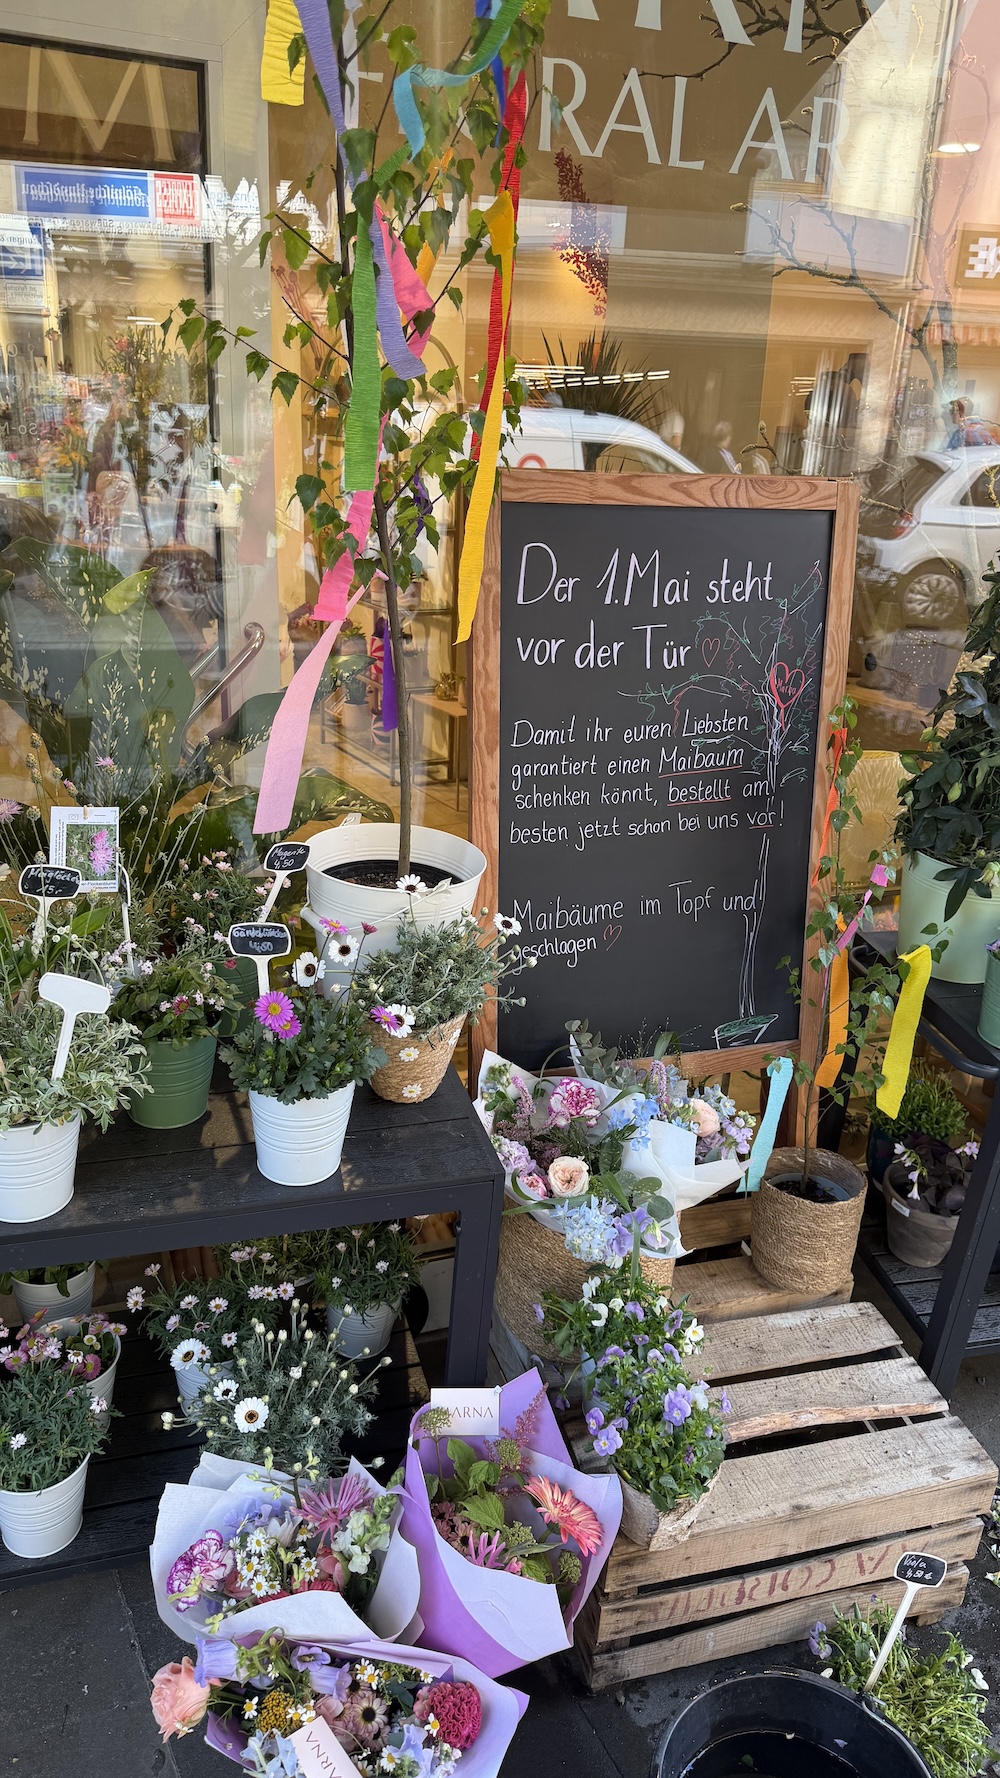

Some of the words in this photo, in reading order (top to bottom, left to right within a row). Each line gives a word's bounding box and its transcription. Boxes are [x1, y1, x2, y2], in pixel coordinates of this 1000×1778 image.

[516, 542, 580, 606] Der
[706, 558, 774, 604] steht
[516, 635, 566, 666] vor
[574, 619, 624, 669] der
[632, 624, 691, 669] Tür
[511, 715, 577, 748] Damit
[586, 718, 612, 743] ihr
[624, 722, 672, 744] euren
[682, 709, 749, 738] Liebsten
[512, 756, 597, 792] garantiert
[608, 755, 650, 776] einen
[658, 746, 744, 774] Maibaum
[514, 785, 590, 810] schenken
[600, 787, 658, 806] könnt,
[668, 778, 732, 803] bestellt
[742, 780, 770, 798] am
[510, 821, 569, 844] besten
[576, 820, 621, 852] jetzt
[628, 819, 671, 837] schon
[678, 812, 701, 832] bei
[707, 810, 739, 830] uns
[512, 896, 624, 934] Maibäume
[640, 895, 661, 916] im
[668, 879, 716, 922] Topf
[723, 887, 757, 912] und
[444, 1406, 494, 1418] ARNA
